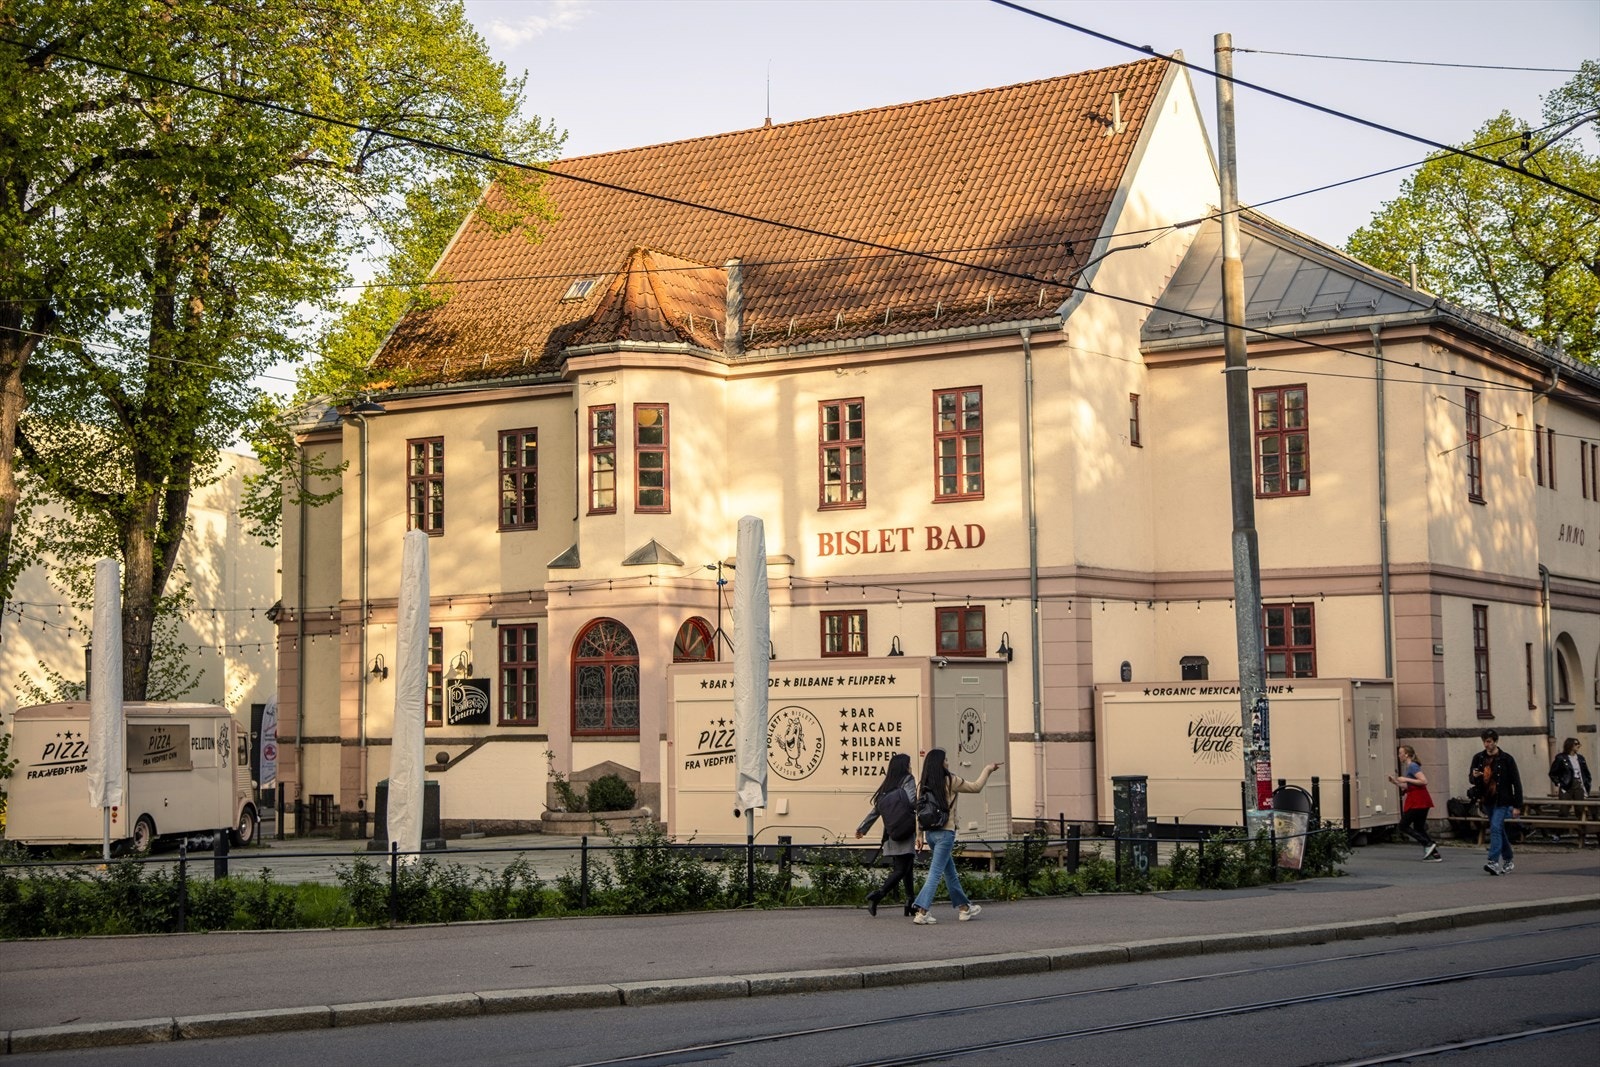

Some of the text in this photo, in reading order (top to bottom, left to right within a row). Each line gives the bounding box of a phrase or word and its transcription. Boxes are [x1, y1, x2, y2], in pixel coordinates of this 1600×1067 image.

[817, 523, 986, 557] BISLET BAD
[1557, 523, 1586, 546] ANNO
[709, 675, 886, 689] BAR BILBANE FLIPPER
[1152, 687, 1196, 696] ORGANIC
[791, 710, 815, 726] BISLETT
[851, 708, 874, 718] BAR
[852, 722, 902, 732] ARCADE
[1188, 718, 1243, 741] Vaquera
[149, 734, 171, 750] PIZZA
[191, 737, 215, 750] PELOTON
[698, 729, 736, 750] PIZZ
[852, 736, 901, 747] BILBANE
[1193, 737, 1234, 754] Verde
[806, 737, 823, 772] POLLETT
[143, 758, 151, 766] FRA
[685, 761, 701, 770] FRA
[27, 770, 43, 780] FRA
[852, 766, 887, 776] PIZZA
